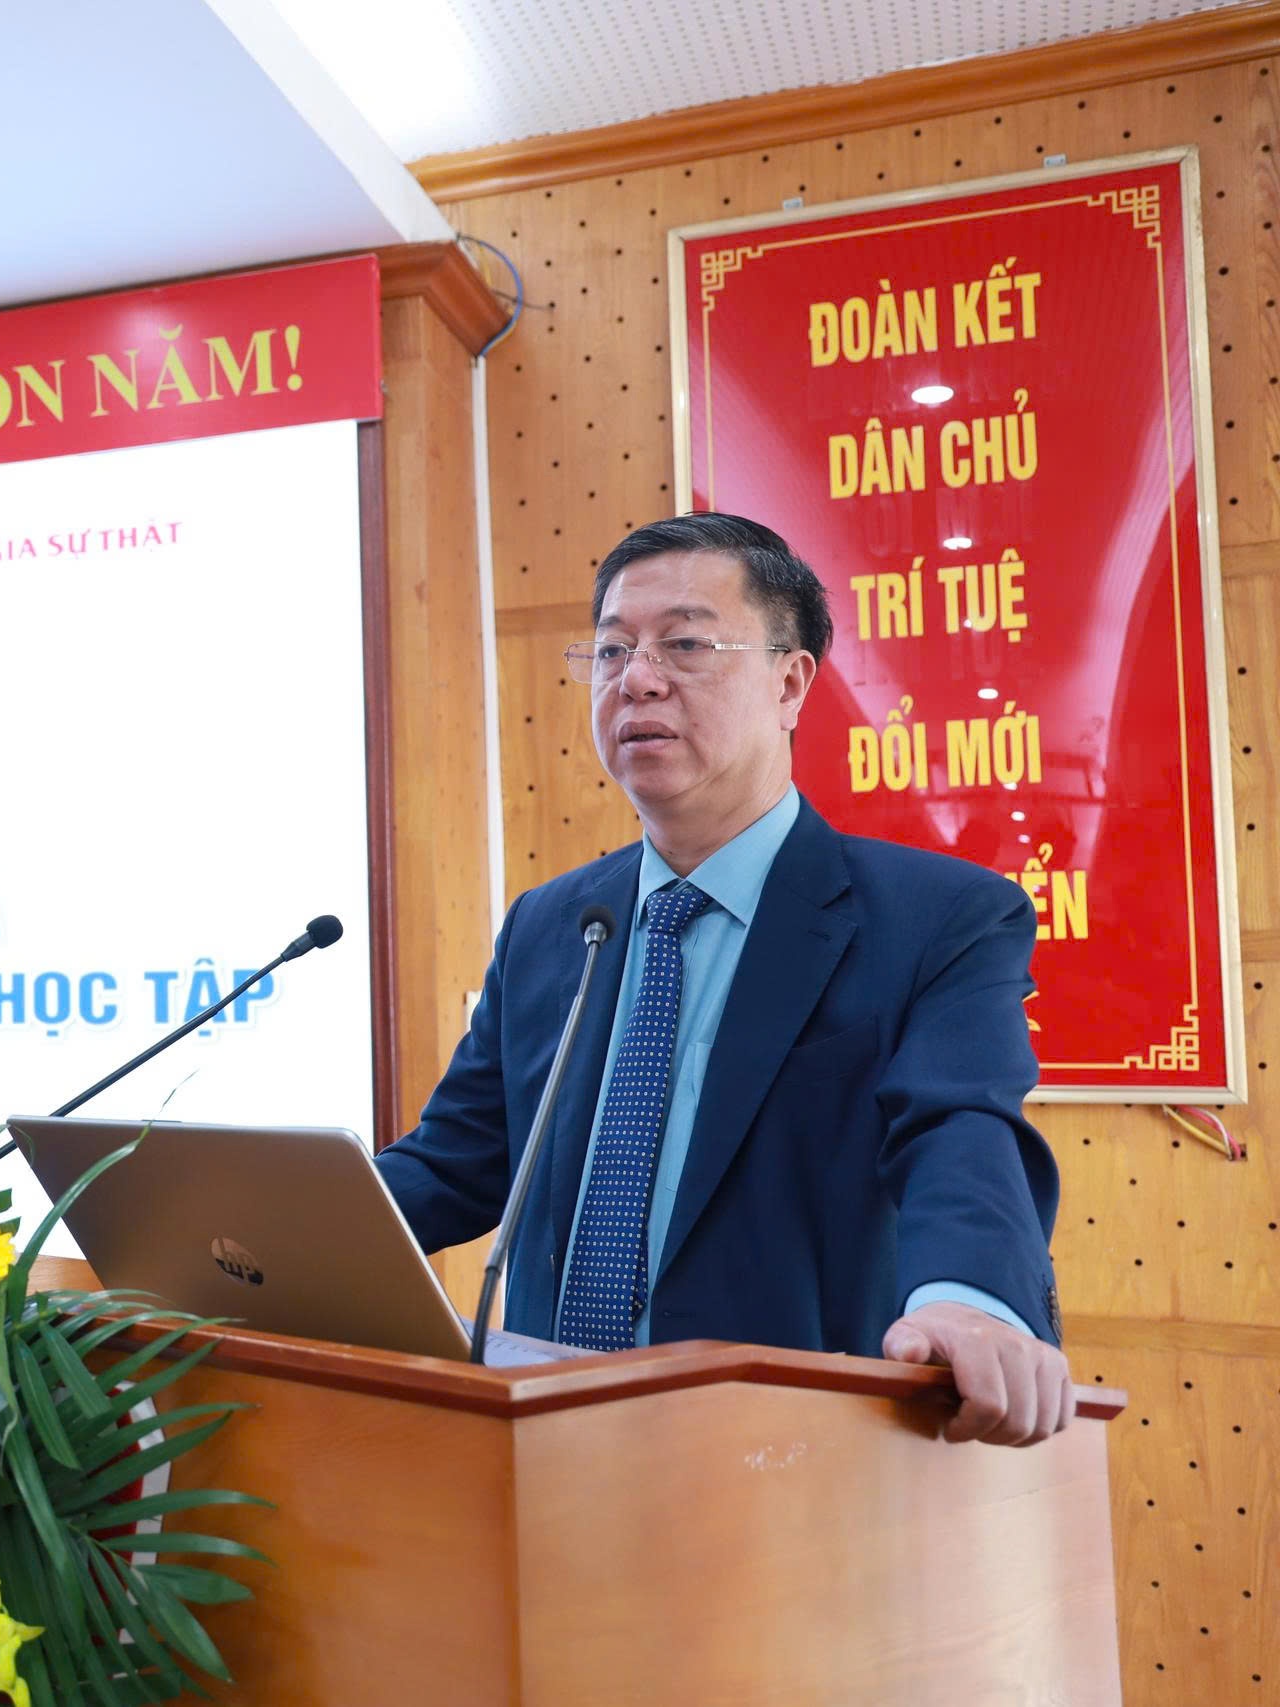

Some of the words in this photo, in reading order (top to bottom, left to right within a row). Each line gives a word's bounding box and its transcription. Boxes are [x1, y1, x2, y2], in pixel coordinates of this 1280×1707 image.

[809, 280, 937, 366] ĐOÀN
[954, 258, 1040, 347] KẾT
[88, 323, 305, 416] NĂM!
[829, 418, 925, 499] DÂN
[941, 389, 1037, 487] CHỦ
[851, 557, 923, 640] TRÍ
[938, 549, 1027, 642] TUỆ
[849, 696, 928, 792] ĐỔI
[946, 701, 1041, 787] MỚI
[144, 957, 275, 1037] TẬP
[211, 1237, 264, 1288] hp
